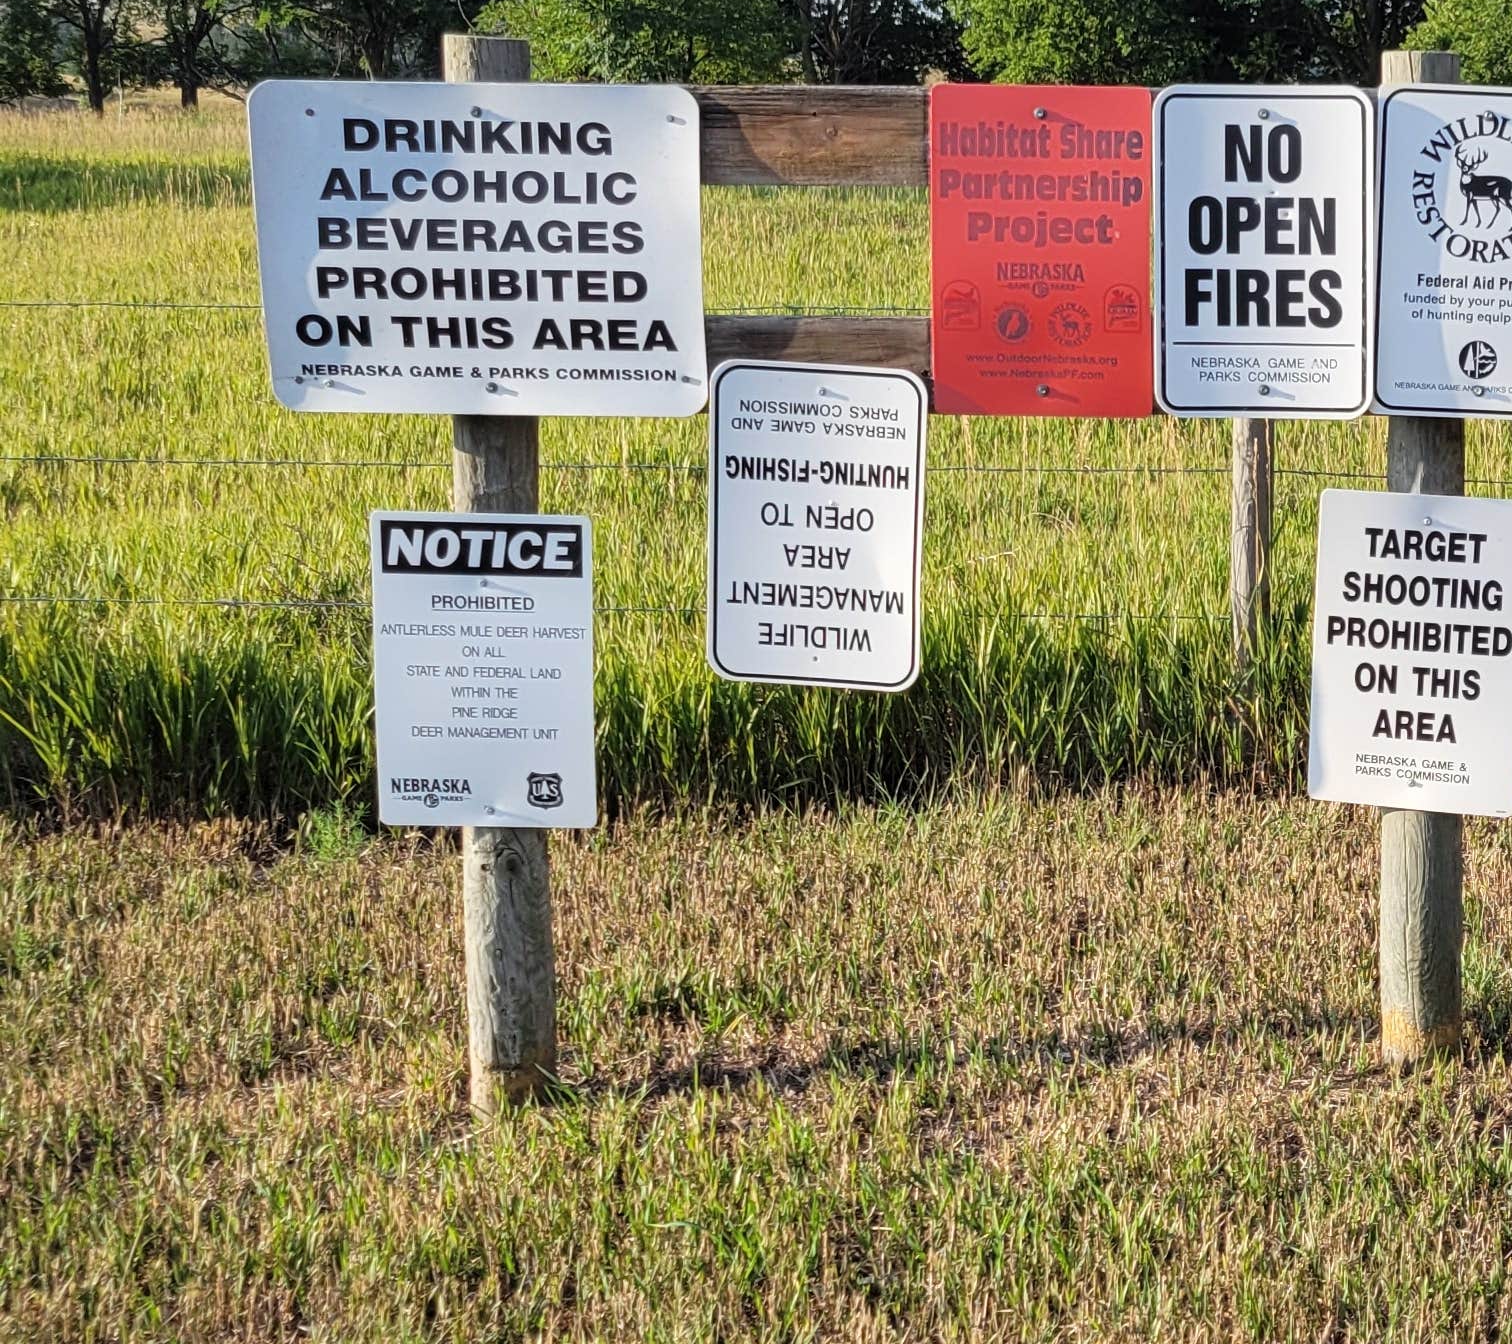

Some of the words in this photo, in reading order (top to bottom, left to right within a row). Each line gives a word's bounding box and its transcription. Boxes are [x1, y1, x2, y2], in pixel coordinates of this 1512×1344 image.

[342, 118, 612, 156] DRINKING
[939, 121, 1051, 157] Habitat
[1060, 124, 1143, 160] Share
[1224, 123, 1302, 184] NO
[319, 167, 637, 206] ALCOHOLIC
[939, 169, 1143, 207] Partnership
[317, 217, 645, 255] BEVERAGES
[967, 211, 1114, 248] Project
[1188, 195, 1337, 256] OPEN
[996, 262, 1085, 283] NEBRASKA
[1417, 273, 1469, 289] Federal
[1472, 275, 1495, 290] Aid
[316, 266, 648, 303] PROHIBITED
[1184, 268, 1343, 329] FIRES
[1403, 292, 1446, 305] funded
[1449, 294, 1465, 308] by
[1467, 297, 1496, 309] your
[1411, 308, 1424, 320] of
[1426, 308, 1474, 324] hunting
[295, 313, 373, 347] ON
[390, 316, 514, 350] THIS
[532, 318, 678, 352] AREA
[301, 364, 403, 377] NEBRASKA
[409, 365, 464, 378] GAME
[470, 366, 483, 379] &
[488, 367, 550, 380] PARKS
[555, 368, 677, 382] COMMISSION
[1191, 356, 1261, 369] NEBRASKA
[1267, 357, 1305, 369] GAME
[1311, 358, 1338, 370] AND
[1199, 370, 1241, 383] PARKS
[1247, 371, 1331, 384] COMMISSION
[739, 399, 842, 418] COMMISSION
[849, 405, 899, 422] PARKS
[731, 417, 764, 431] AND
[770, 419, 816, 434] GAME
[822, 422, 906, 441] NEBRASKA
[725, 455, 910, 490] HUNTING-FISHING
[760, 501, 794, 527] TO
[806, 504, 874, 532] OPEN
[387, 528, 577, 570] NOTICE
[782, 543, 851, 571] AREA
[1364, 527, 1488, 564] TARGET
[431, 594, 535, 611] PROHIBITED
[726, 580, 904, 615] MANAGEMENT
[1342, 571, 1503, 612] SHOOTING
[380, 623, 456, 637] ANTLERLESS
[460, 624, 493, 638] MULE
[496, 625, 529, 639] DEER
[532, 626, 587, 640] HARVEST
[758, 622, 872, 653] WILDLIFE
[461, 645, 480, 658] ON
[483, 646, 507, 658] ALL
[406, 664, 441, 678] STATE
[444, 665, 469, 678] AND
[472, 666, 527, 679] FEDERAL
[529, 667, 562, 680] LAND
[1354, 662, 1398, 695] ON
[1412, 666, 1481, 701] THIS
[450, 686, 491, 699] WITHIN
[493, 686, 519, 700] THE
[451, 706, 479, 719] PINE
[481, 706, 519, 720] RIDGE
[411, 725, 444, 738] DEER
[447, 726, 529, 740] MANAGEMENT
[532, 728, 560, 741] UNIT
[1371, 708, 1457, 744] AREA
[1355, 753, 1417, 768] NEBRASKA
[1421, 759, 1454, 771] GAME
[1459, 762, 1467, 772] &
[1355, 765, 1392, 778] PARKS
[1396, 768, 1470, 784] COMMISSION
[391, 778, 472, 795] NEBRASKA
